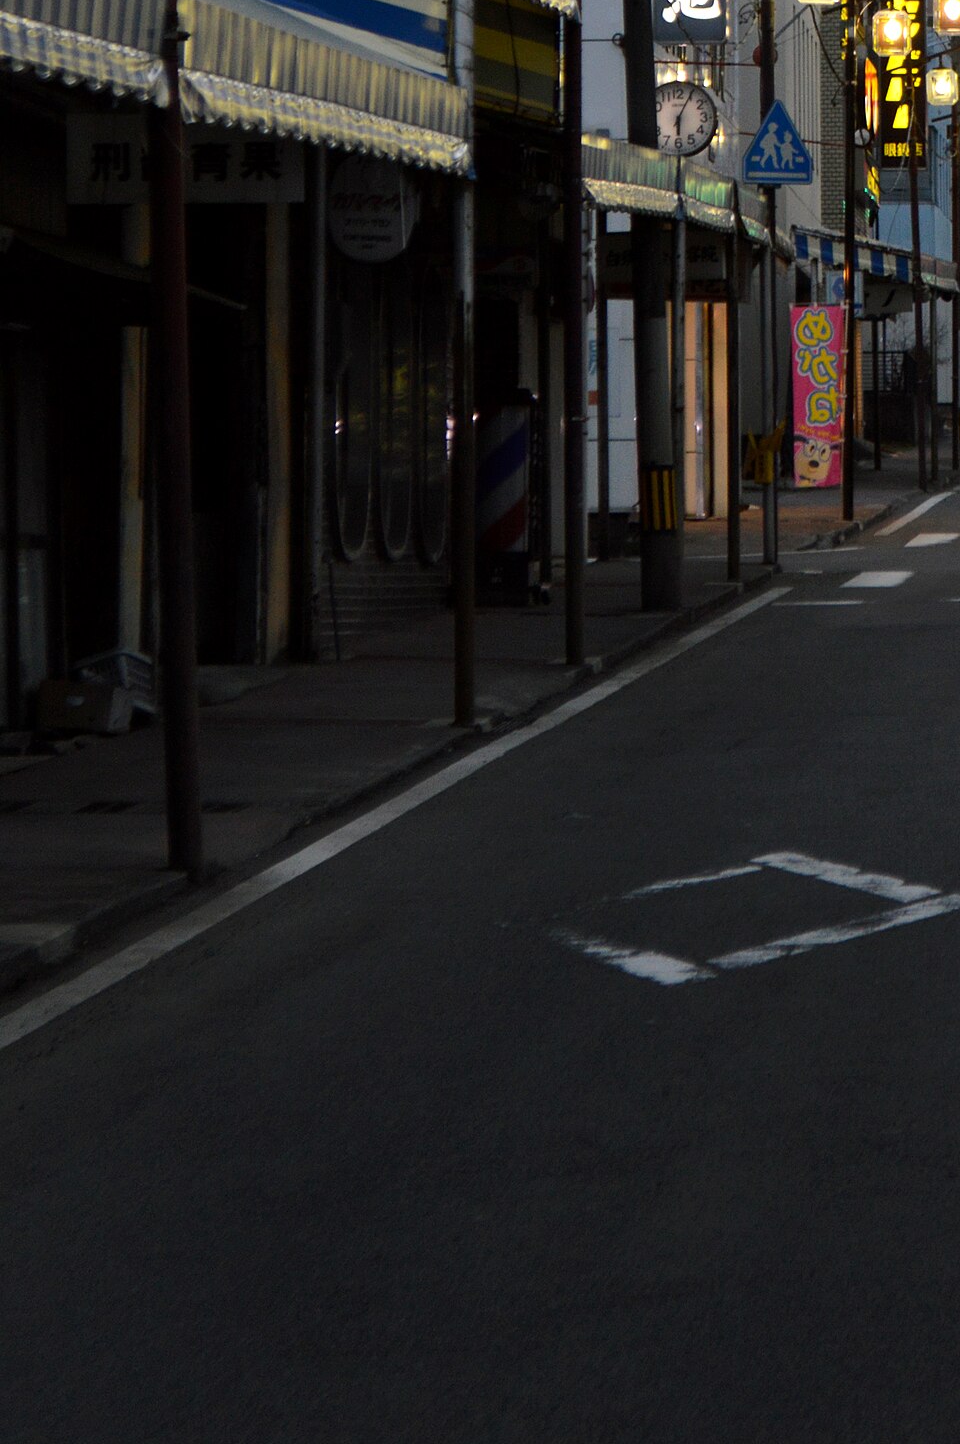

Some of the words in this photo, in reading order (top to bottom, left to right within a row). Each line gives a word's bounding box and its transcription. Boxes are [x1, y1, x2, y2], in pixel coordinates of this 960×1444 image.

[672, 88, 684, 99] 12
[696, 99, 704, 110] 2
[700, 112, 708, 123] 3
[696, 125, 704, 134] 4
[663, 135, 671, 146] 7
[674, 137, 683, 149] 6
[687, 134, 695, 144] 5
[91, 142, 281, 181] 刑青果
